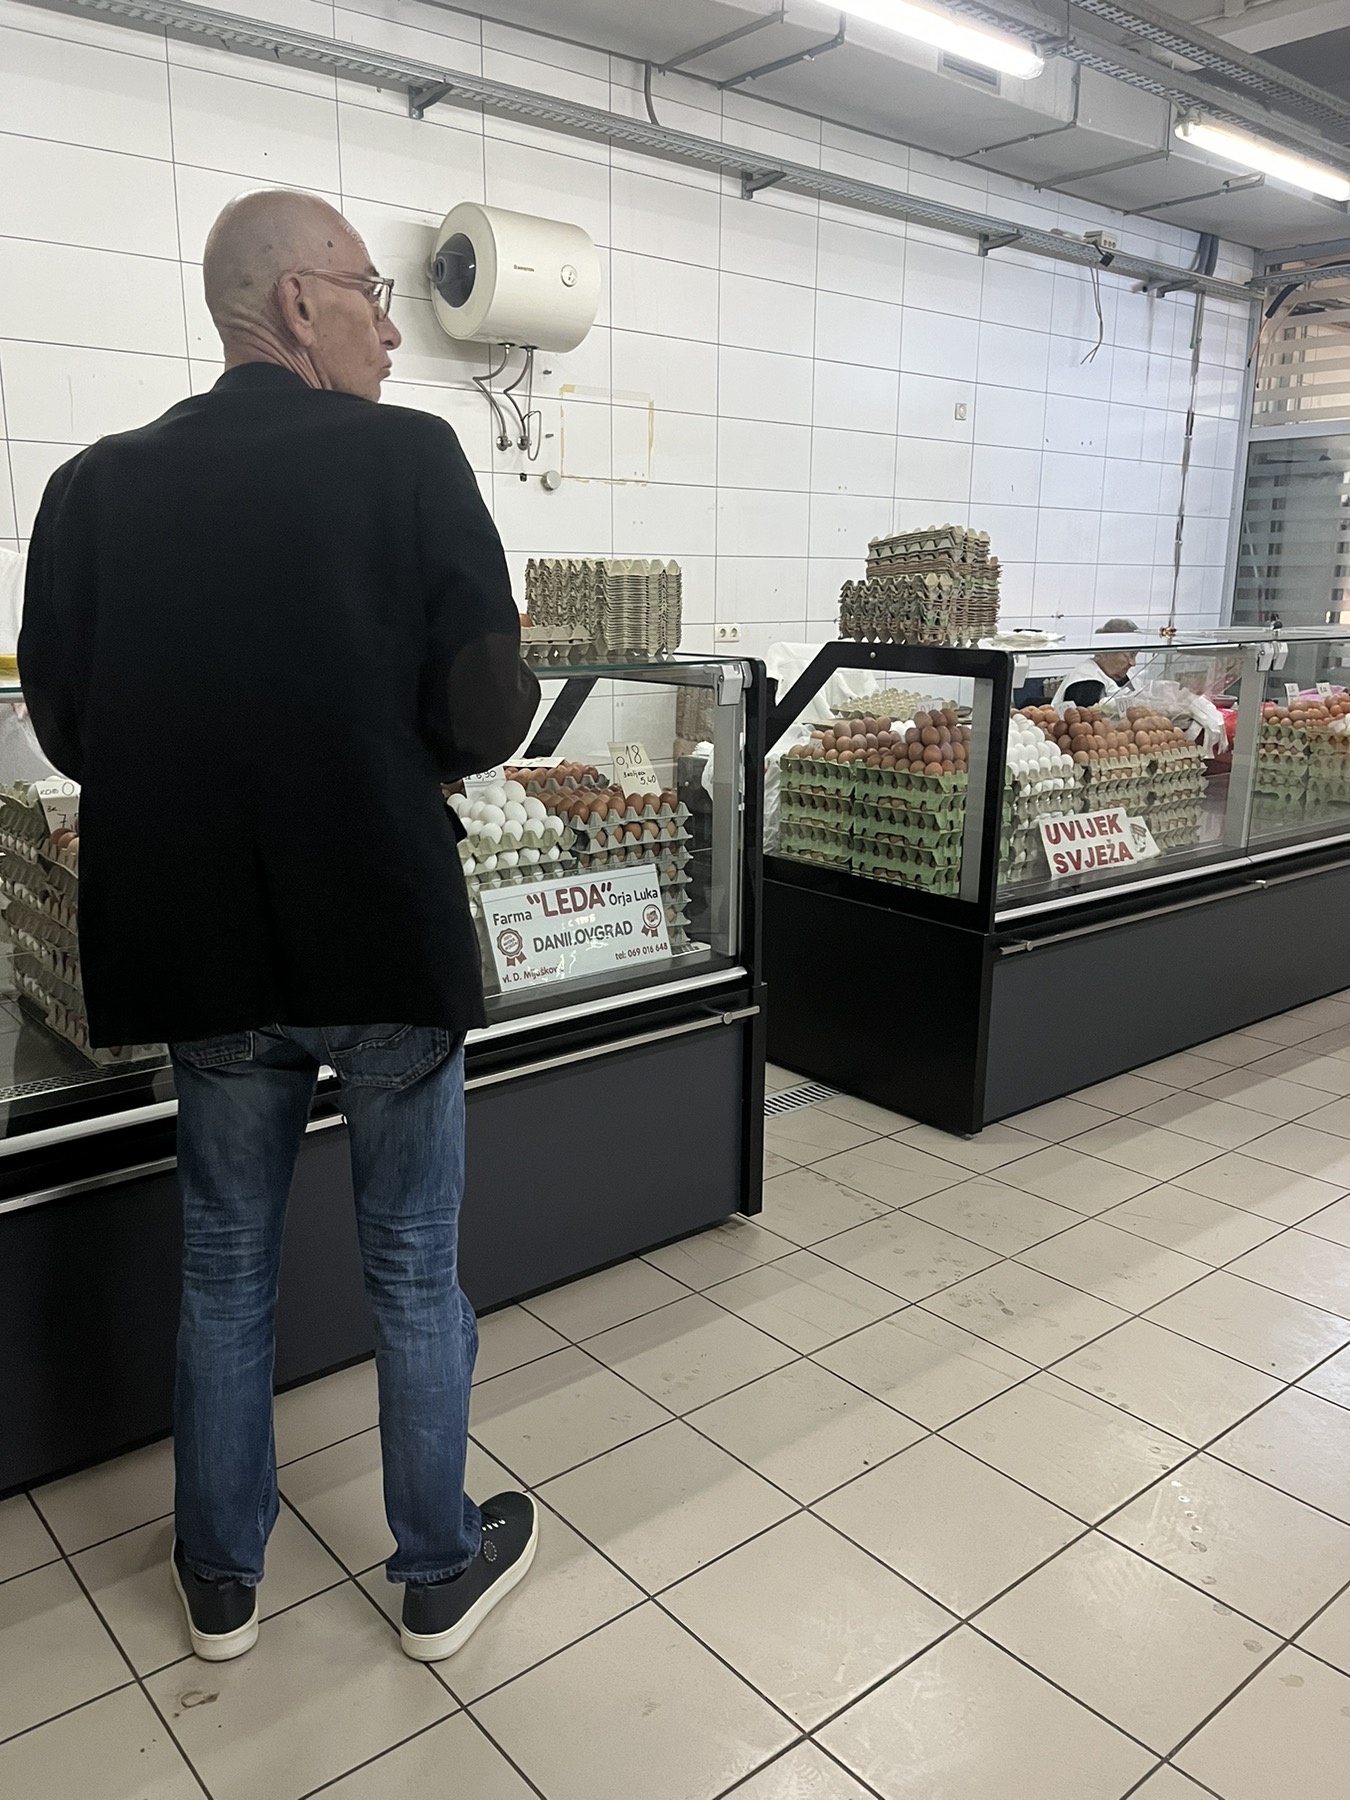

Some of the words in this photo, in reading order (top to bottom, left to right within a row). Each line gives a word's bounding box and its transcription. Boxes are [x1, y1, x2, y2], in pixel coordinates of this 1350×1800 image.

[616, 744, 642, 769] 0,18
[1045, 813, 1123, 845] UVIJEK
[1053, 839, 1134, 874] SVJEŽA
[492, 909, 533, 927] Farma
[608, 891, 633, 908] Orja
[633, 886, 659, 902] Luka
[532, 920, 633, 954] DANILOVGRAD
[627, 947, 641, 958] 069
[642, 944, 654, 955] 016
[655, 942, 668, 952] 648
[512, 972, 522, 982] D.
